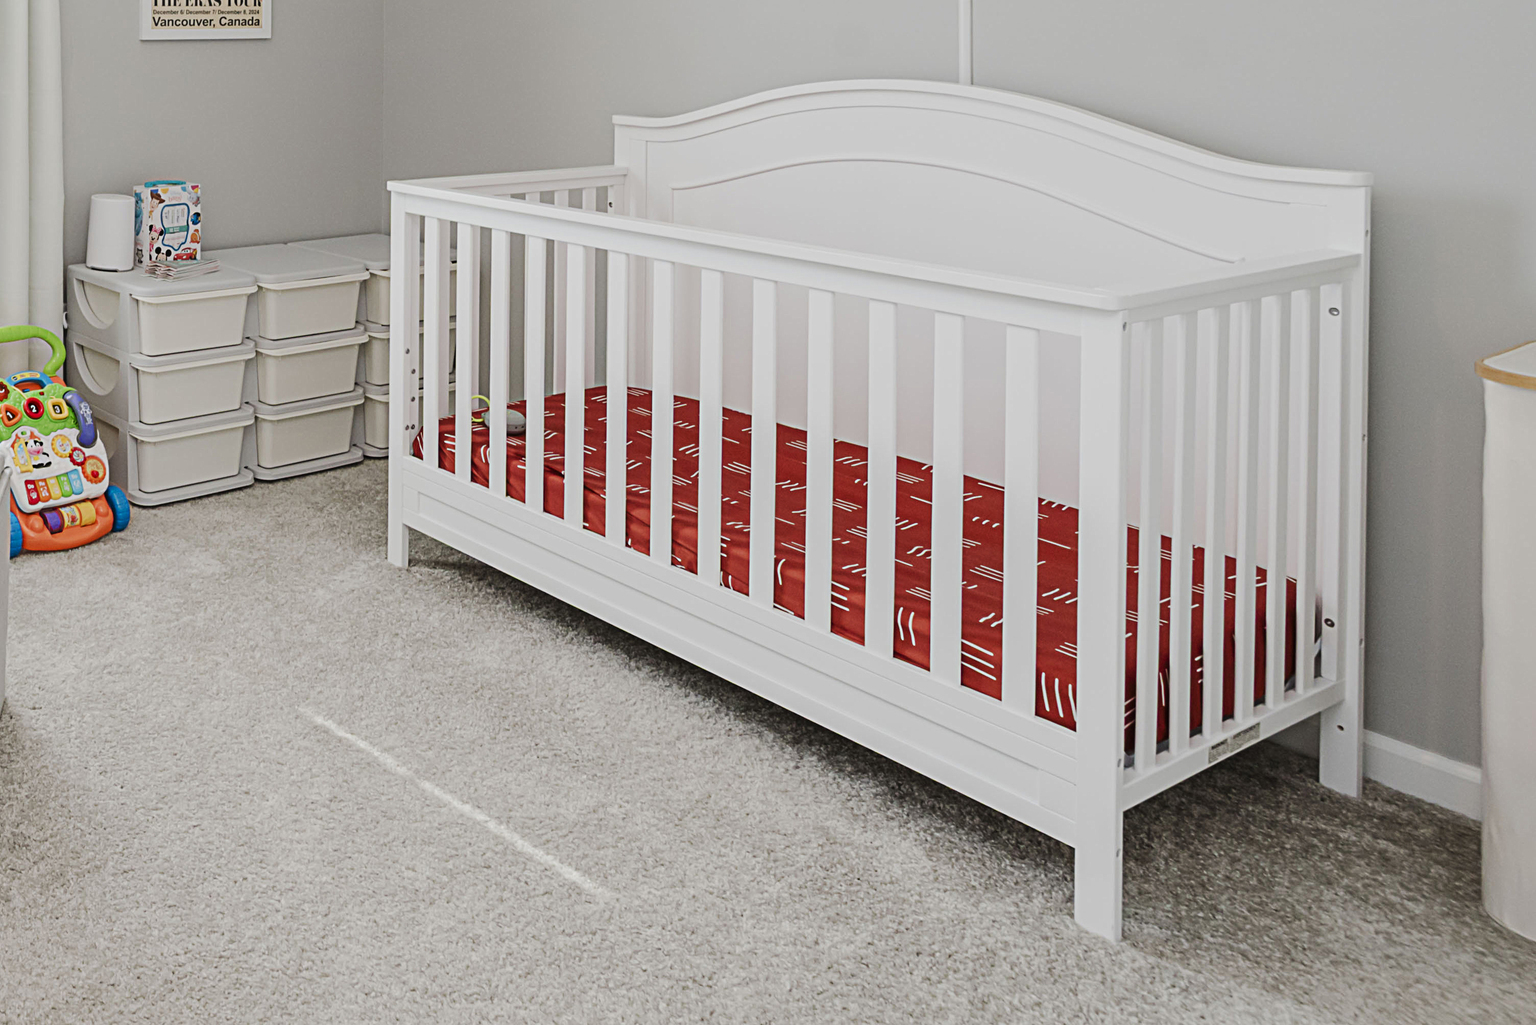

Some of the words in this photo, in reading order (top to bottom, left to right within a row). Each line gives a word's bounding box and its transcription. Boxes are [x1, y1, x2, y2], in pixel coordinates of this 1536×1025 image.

[152, 16, 216, 28] Vancouver,
[219, 16, 260, 27] Canada
[30, 405, 37, 413] 2
[54, 405, 61, 413] 3
